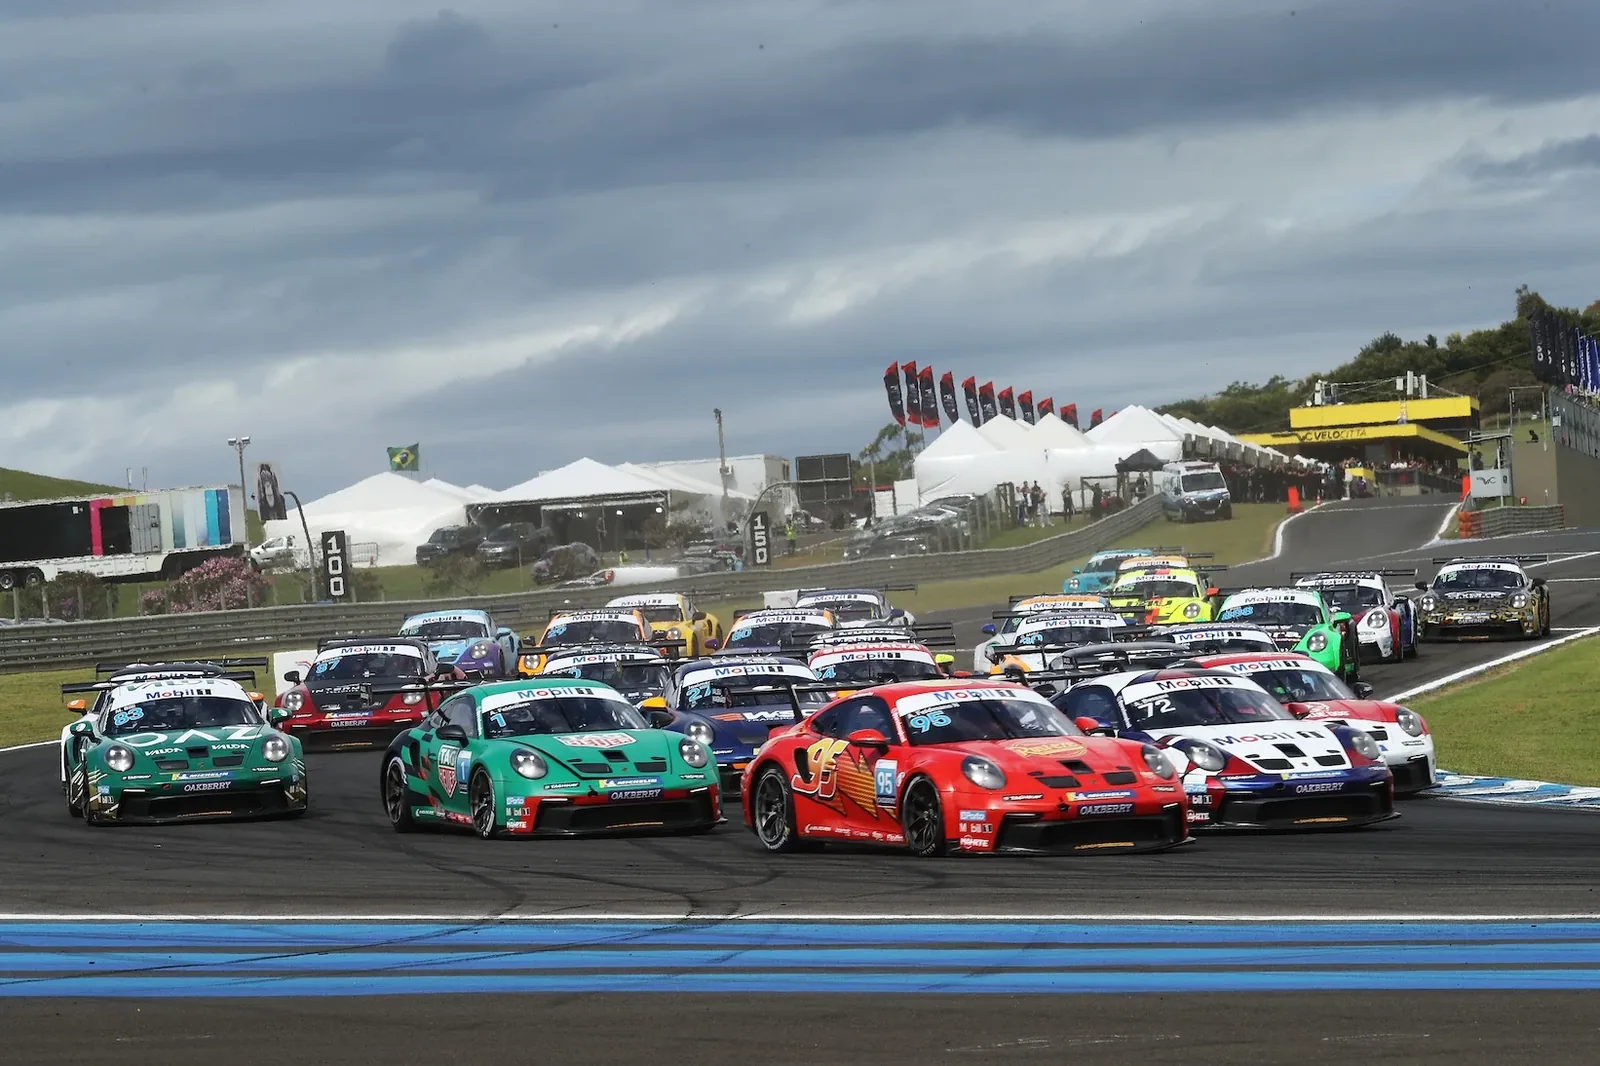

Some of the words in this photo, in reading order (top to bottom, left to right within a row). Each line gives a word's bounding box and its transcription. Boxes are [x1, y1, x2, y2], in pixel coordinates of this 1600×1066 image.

[1314, 429, 1367, 440] VELOCITTA
[752, 515, 767, 564] 150
[326, 536, 344, 597] 100
[755, 615, 792, 623] Mobil
[1045, 619, 1086, 627] Mobil
[1179, 631, 1225, 641] Mobil
[341, 646, 381, 654] Mobil
[572, 655, 614, 664] Mobil
[841, 652, 885, 661] Mobil
[715, 666, 765, 676] Mobil
[1230, 660, 1282, 672] Mobil
[1157, 677, 1214, 691] Mobil
[146, 688, 195, 700] Mobil
[517, 687, 574, 699] Mobil
[686, 684, 712, 702] 27
[933, 689, 994, 702] Mobil
[1137, 699, 1176, 718] 72
[113, 707, 145, 727] 83
[490, 713, 507, 728] 1
[910, 710, 952, 734] 95
[331, 719, 368, 728] OAKBERRY
[1212, 732, 1295, 746] Mobil
[440, 747, 458, 767] TAG
[460, 761, 466, 780] 1
[791, 737, 851, 799] 95
[189, 771, 229, 779] MICHELIN
[184, 781, 232, 792] OAKBERRY
[616, 778, 658, 786] MICHELIN
[876, 771, 893, 795] 95
[1296, 782, 1345, 794] OAKBERRY
[611, 789, 661, 801] OAKBERRY
[1080, 803, 1133, 816] OAKBERRY
